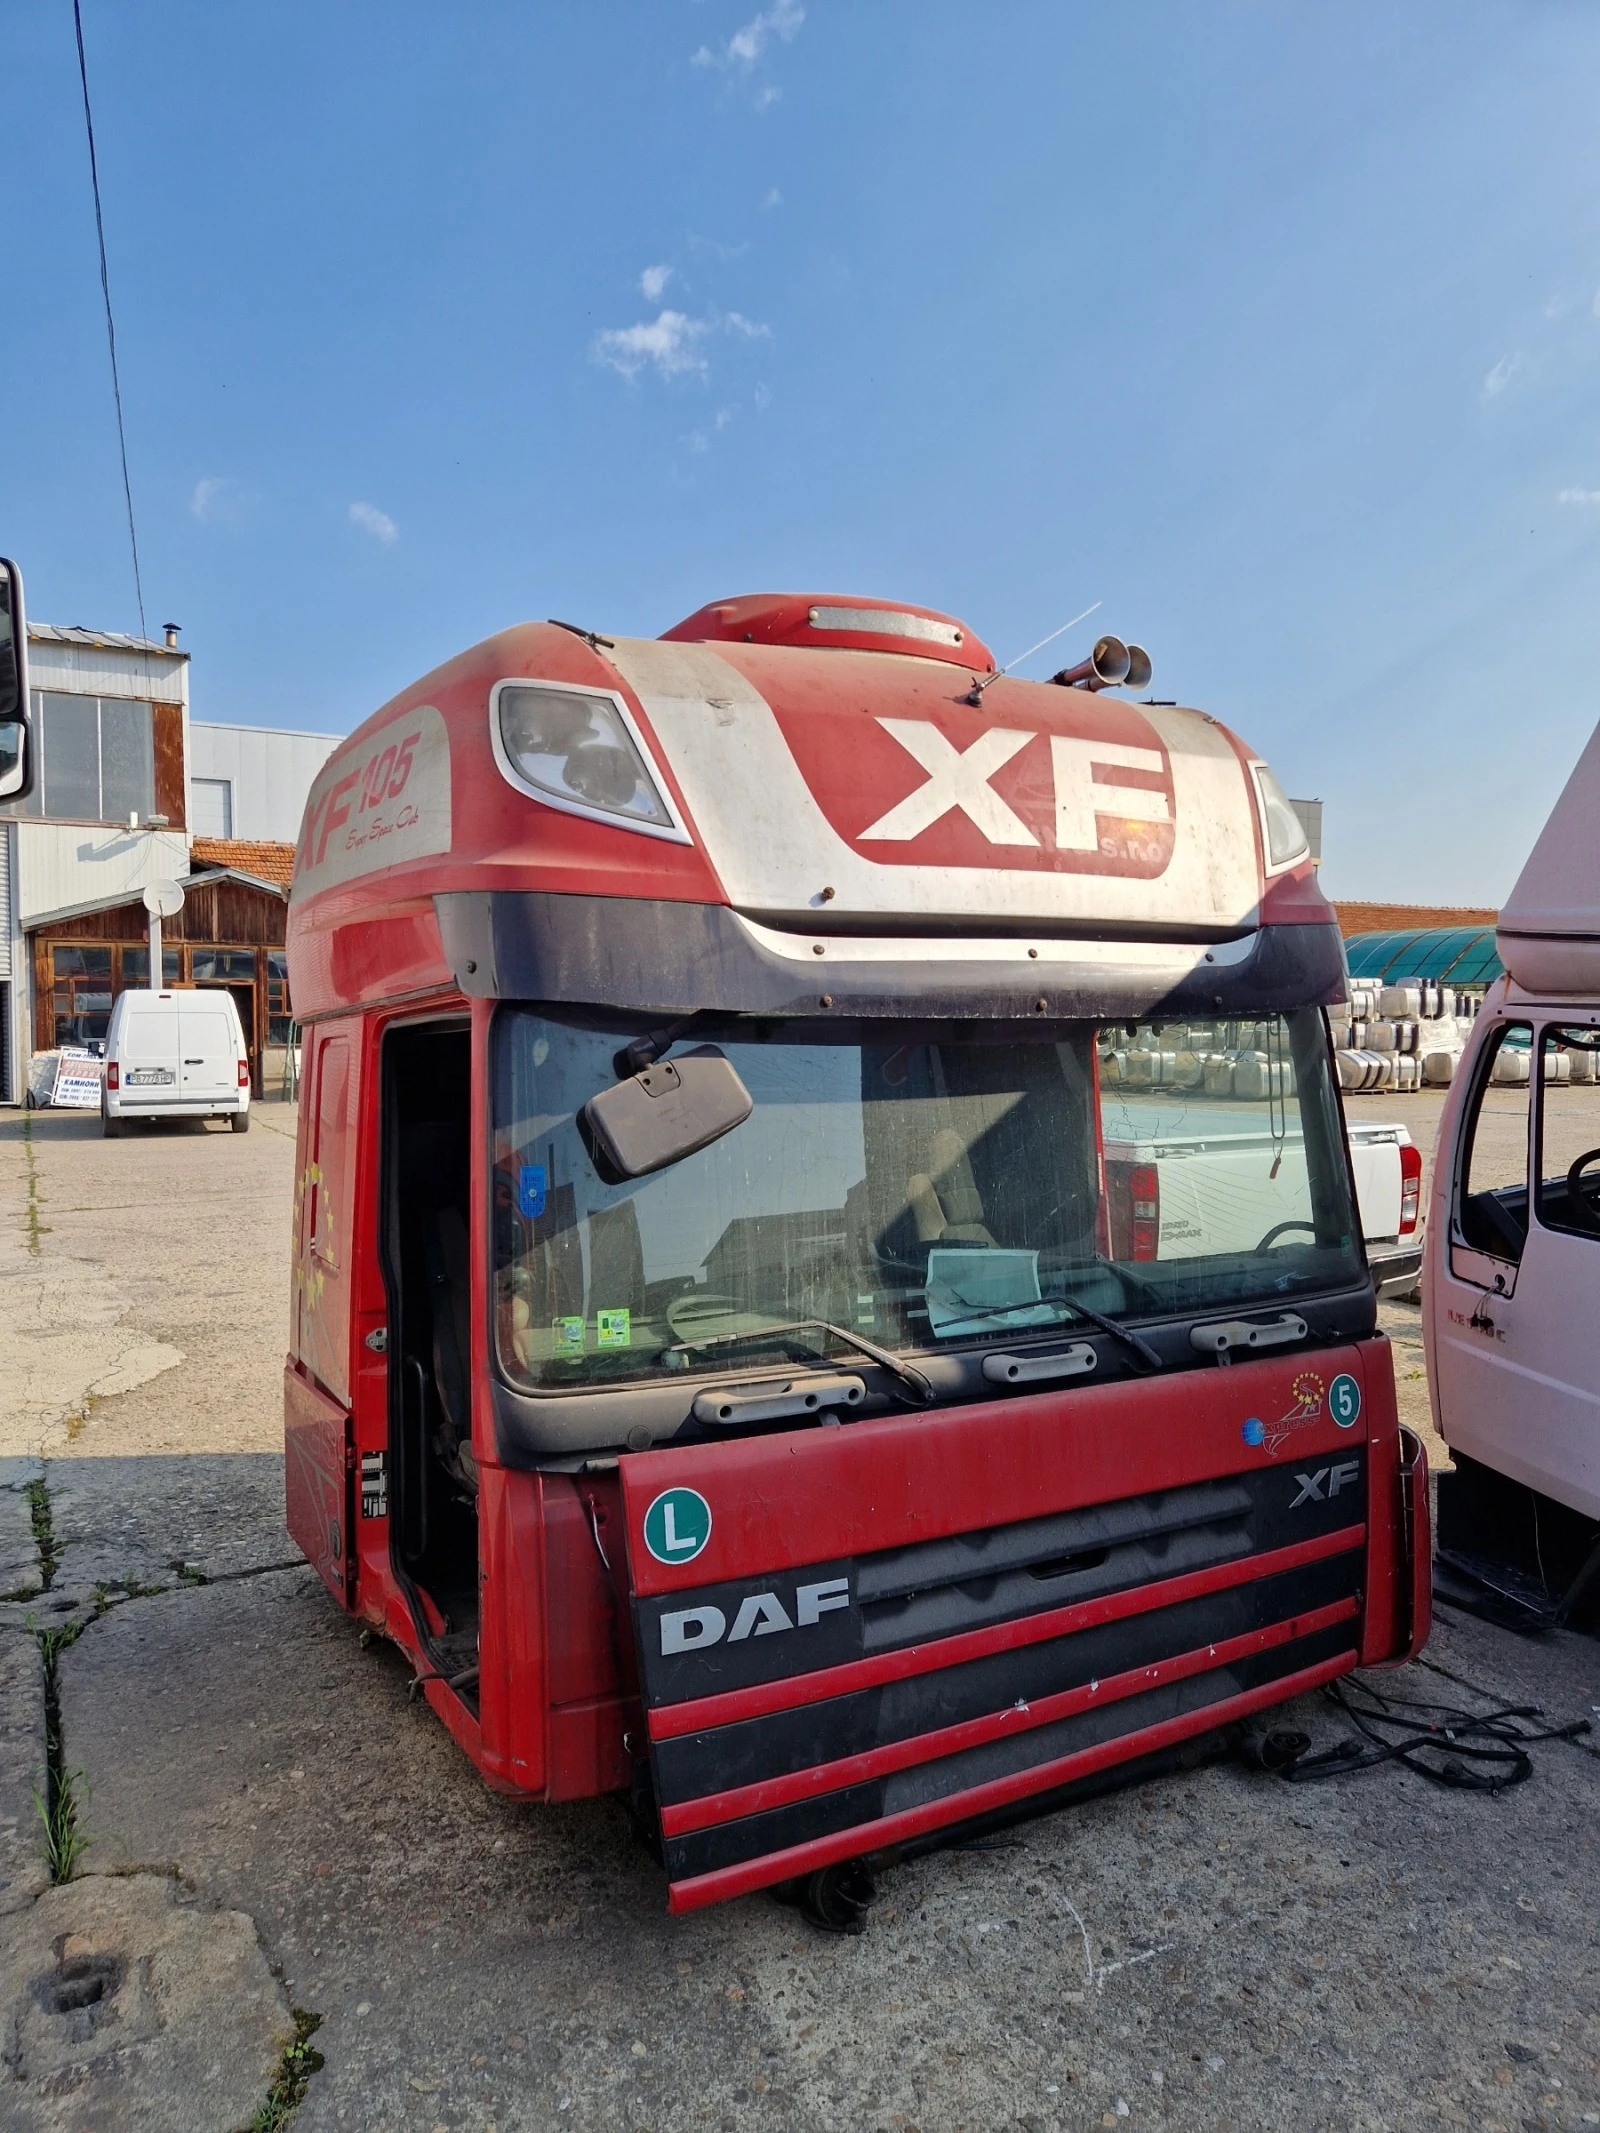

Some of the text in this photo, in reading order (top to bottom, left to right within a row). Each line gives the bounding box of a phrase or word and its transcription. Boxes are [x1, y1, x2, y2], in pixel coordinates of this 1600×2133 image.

[359, 731, 421, 814] 105
[856, 716, 1170, 851] XF
[369, 817, 394, 841] Space
[396, 805, 419, 829] Cab
[64, 1079, 99, 1088] КАМИОНИ
[1338, 1384, 1352, 1416] 5
[1288, 1460, 1359, 1509] XF
[664, 1502, 696, 1551] L
[659, 1577, 849, 1656] DAF
